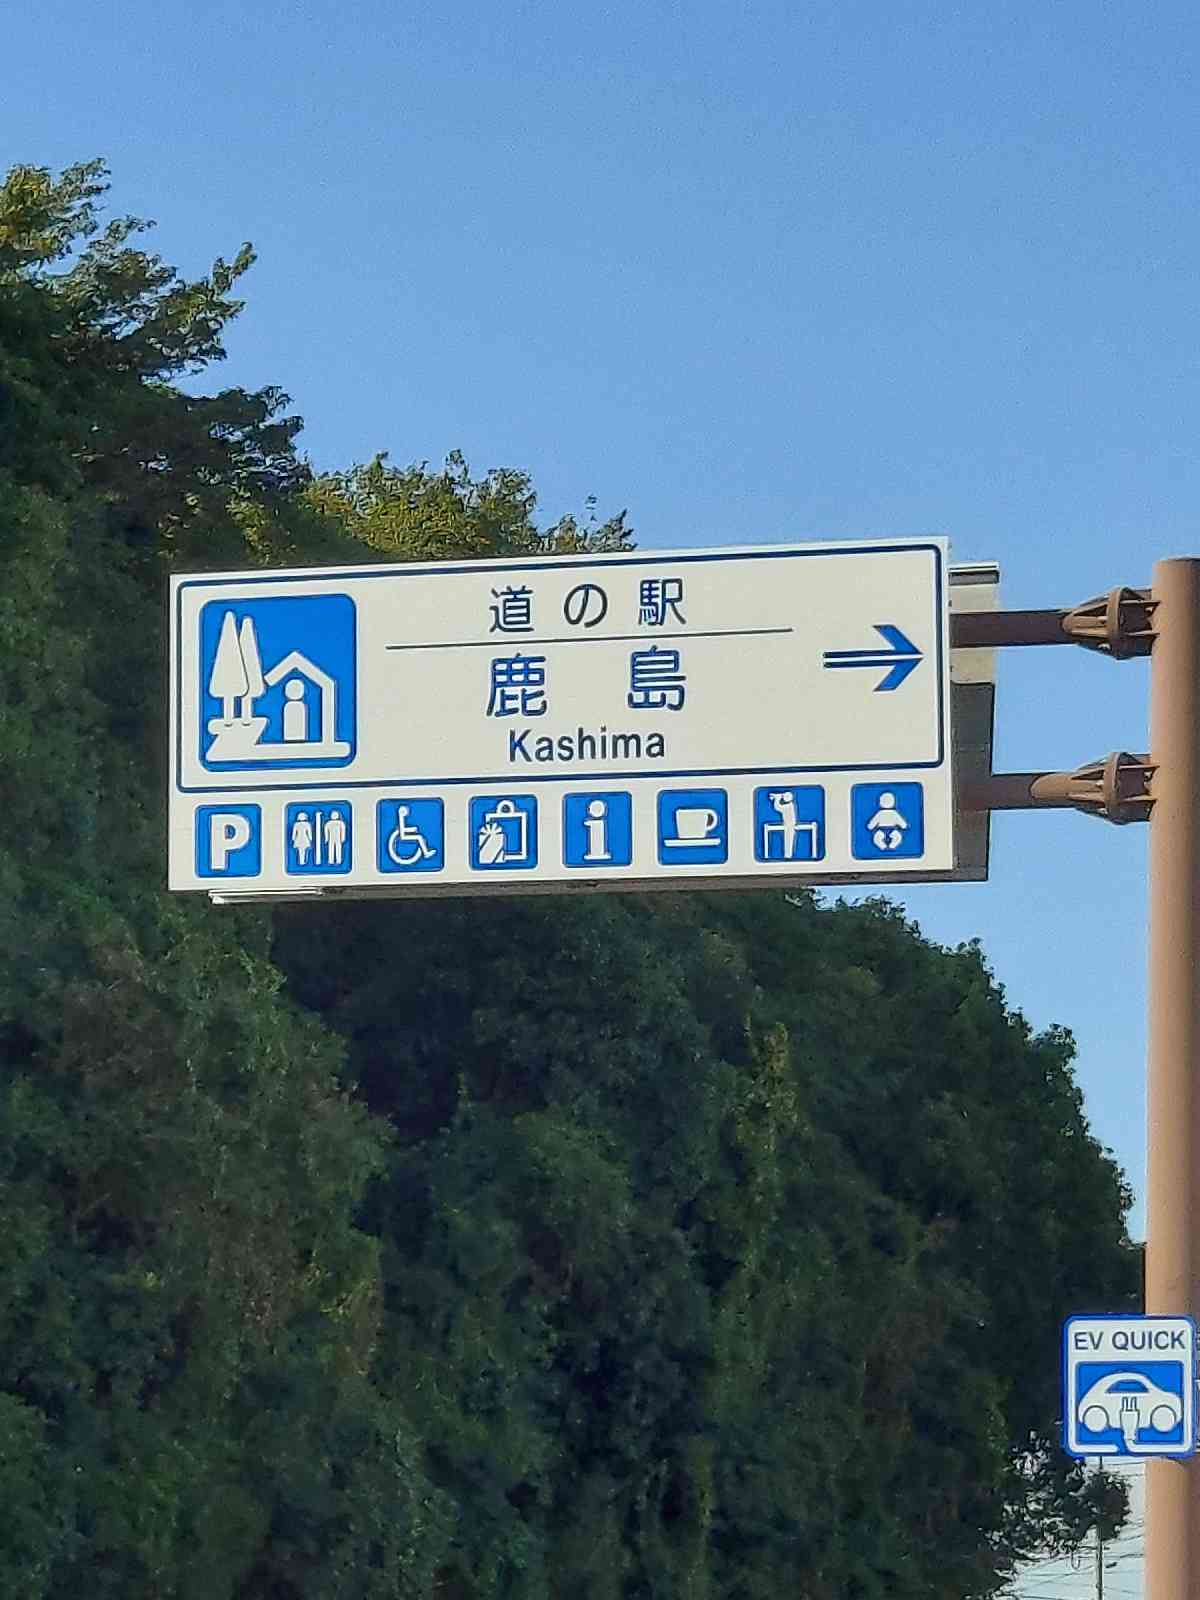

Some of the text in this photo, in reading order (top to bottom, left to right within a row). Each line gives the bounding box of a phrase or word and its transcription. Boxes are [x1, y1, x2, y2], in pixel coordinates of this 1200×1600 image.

[488, 578, 686, 633] 道の駅
[486, 646, 686, 717] 鹿島
[508, 725, 666, 764] Kashima
[209, 813, 251, 872] P
[1074, 1331, 1186, 1350] EV QUICK
